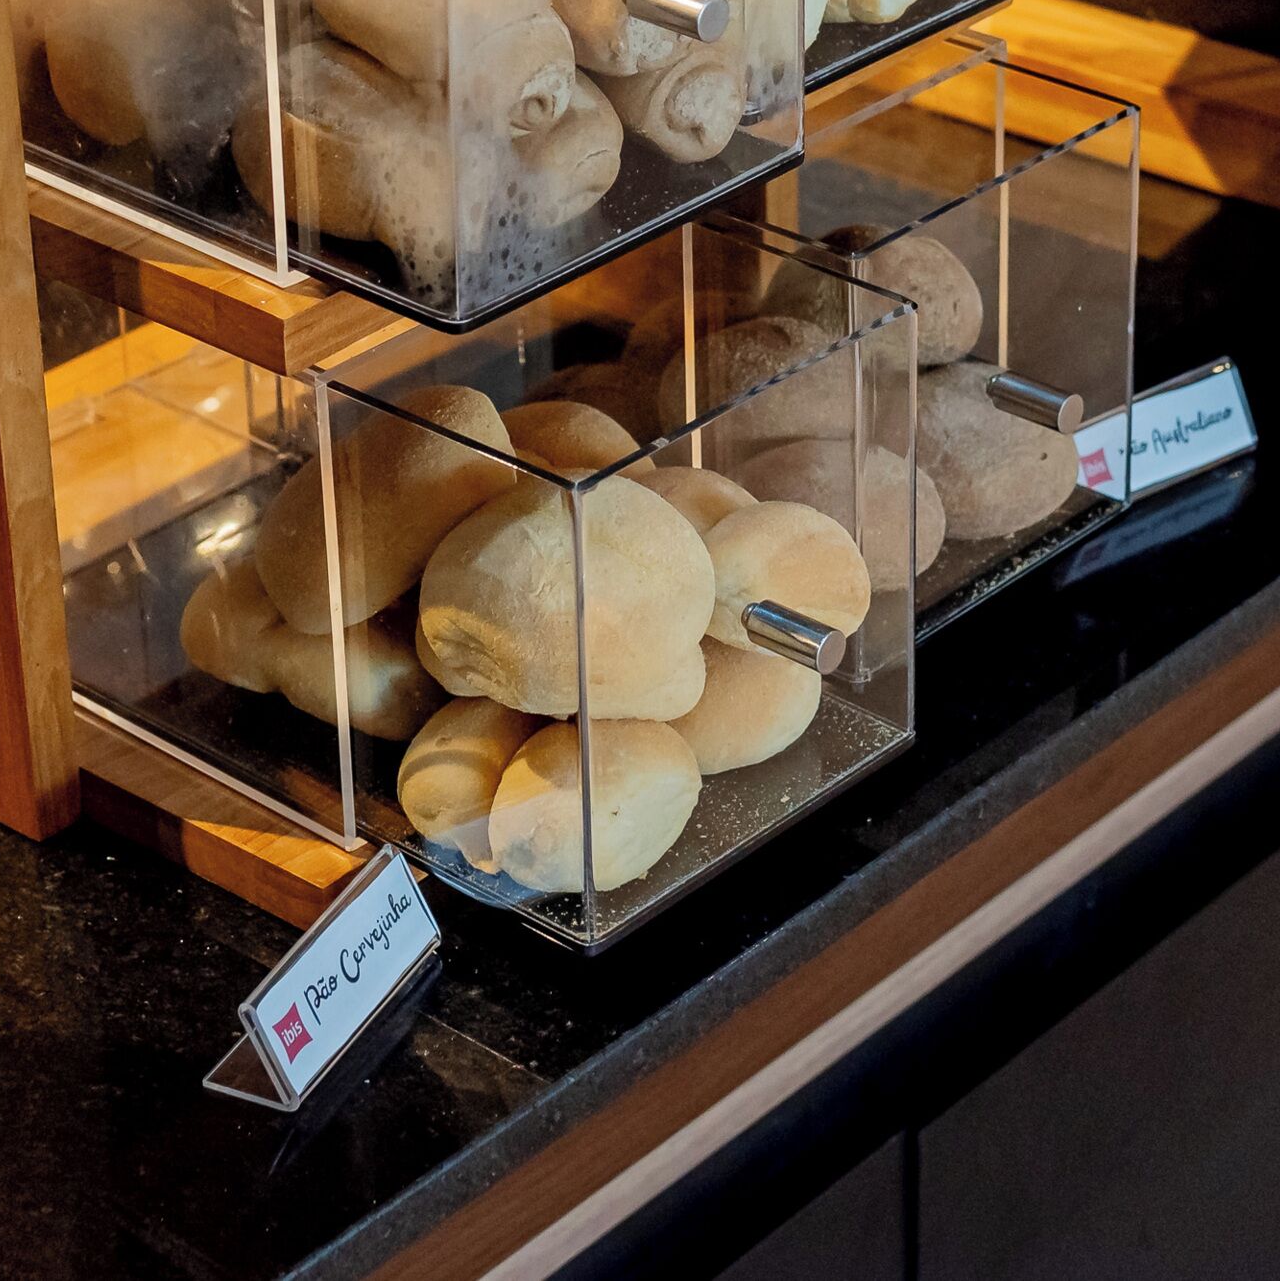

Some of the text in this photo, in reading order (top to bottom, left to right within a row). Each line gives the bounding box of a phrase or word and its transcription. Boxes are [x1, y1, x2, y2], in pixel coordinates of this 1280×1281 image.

[304, 893, 412, 1026] Pão Cervejinha
[281, 1020, 303, 1047] ibis
